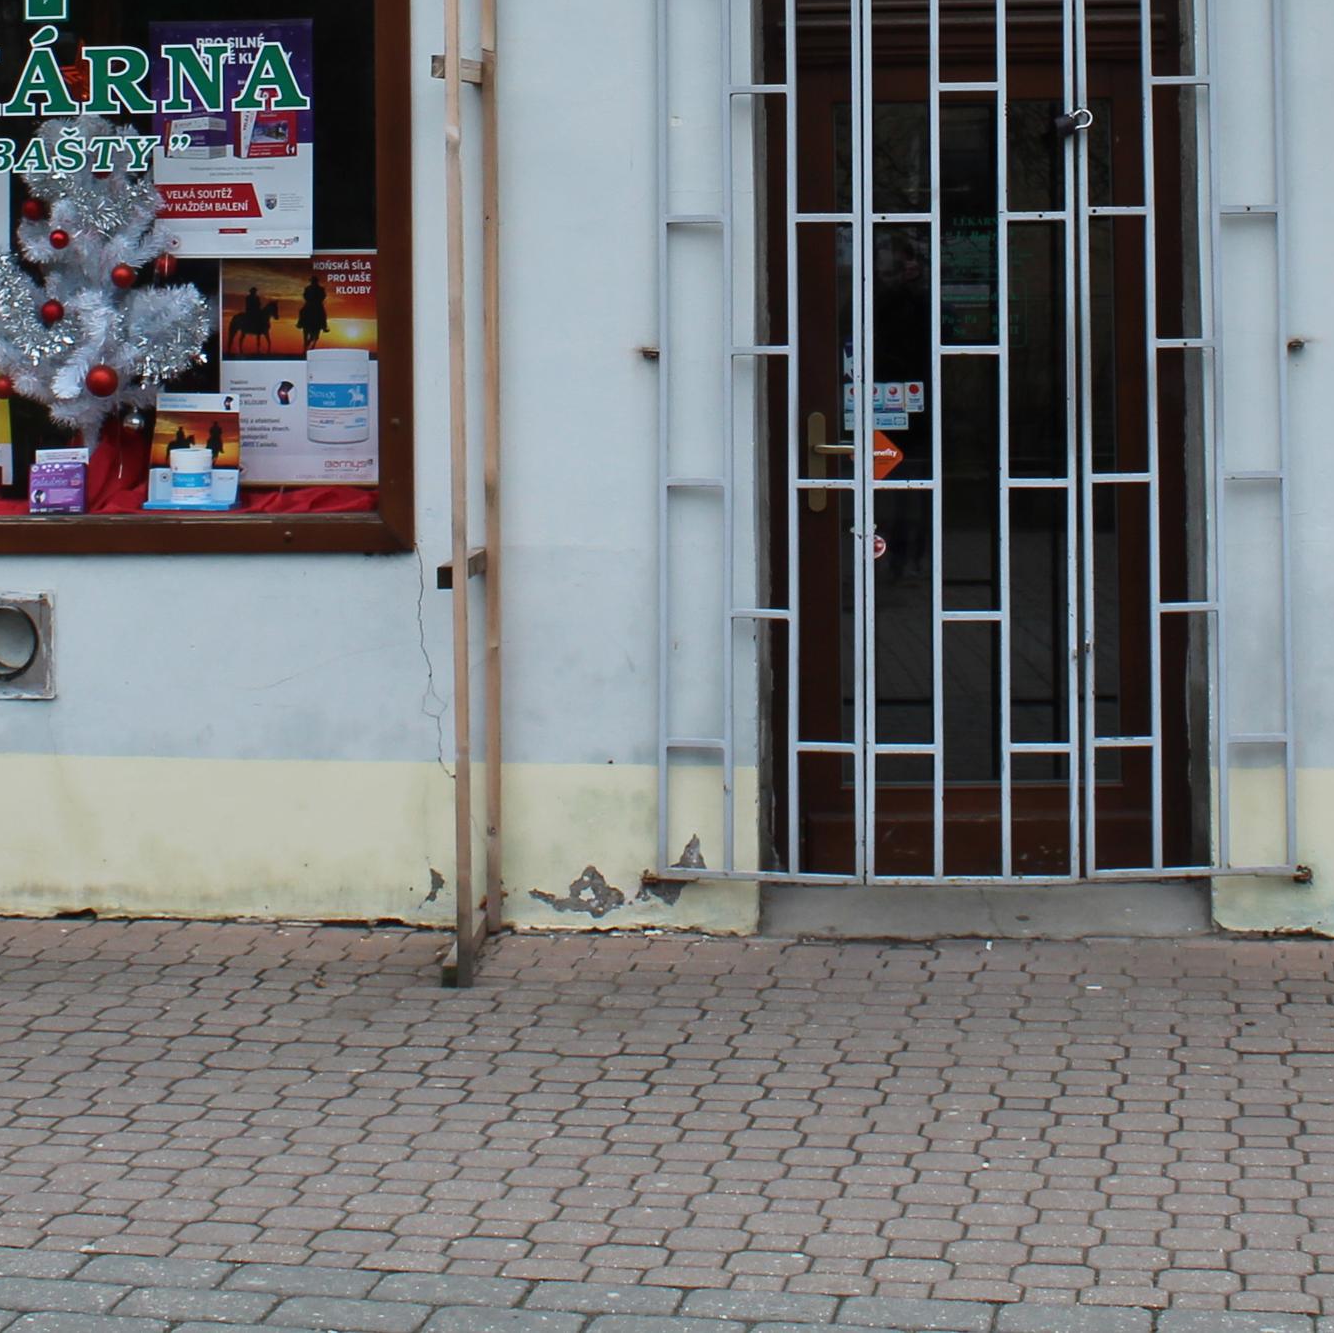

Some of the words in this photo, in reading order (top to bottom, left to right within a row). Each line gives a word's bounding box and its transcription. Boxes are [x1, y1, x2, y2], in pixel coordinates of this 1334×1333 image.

[227, 33, 265, 48] SILNÉ
[167, 189, 195, 198] VELKÁ
[198, 188, 232, 198] SOUTĚŽ
[175, 201, 213, 211] KAŽDÉM
[215, 200, 248, 211] BALENÍ
[352, 259, 371, 270] SÍLA
[328, 274, 346, 282] PRO
[348, 273, 371, 282] VAŠE
[336, 286, 371, 294] KLOUBY
[873, 448, 898, 458] enefity
